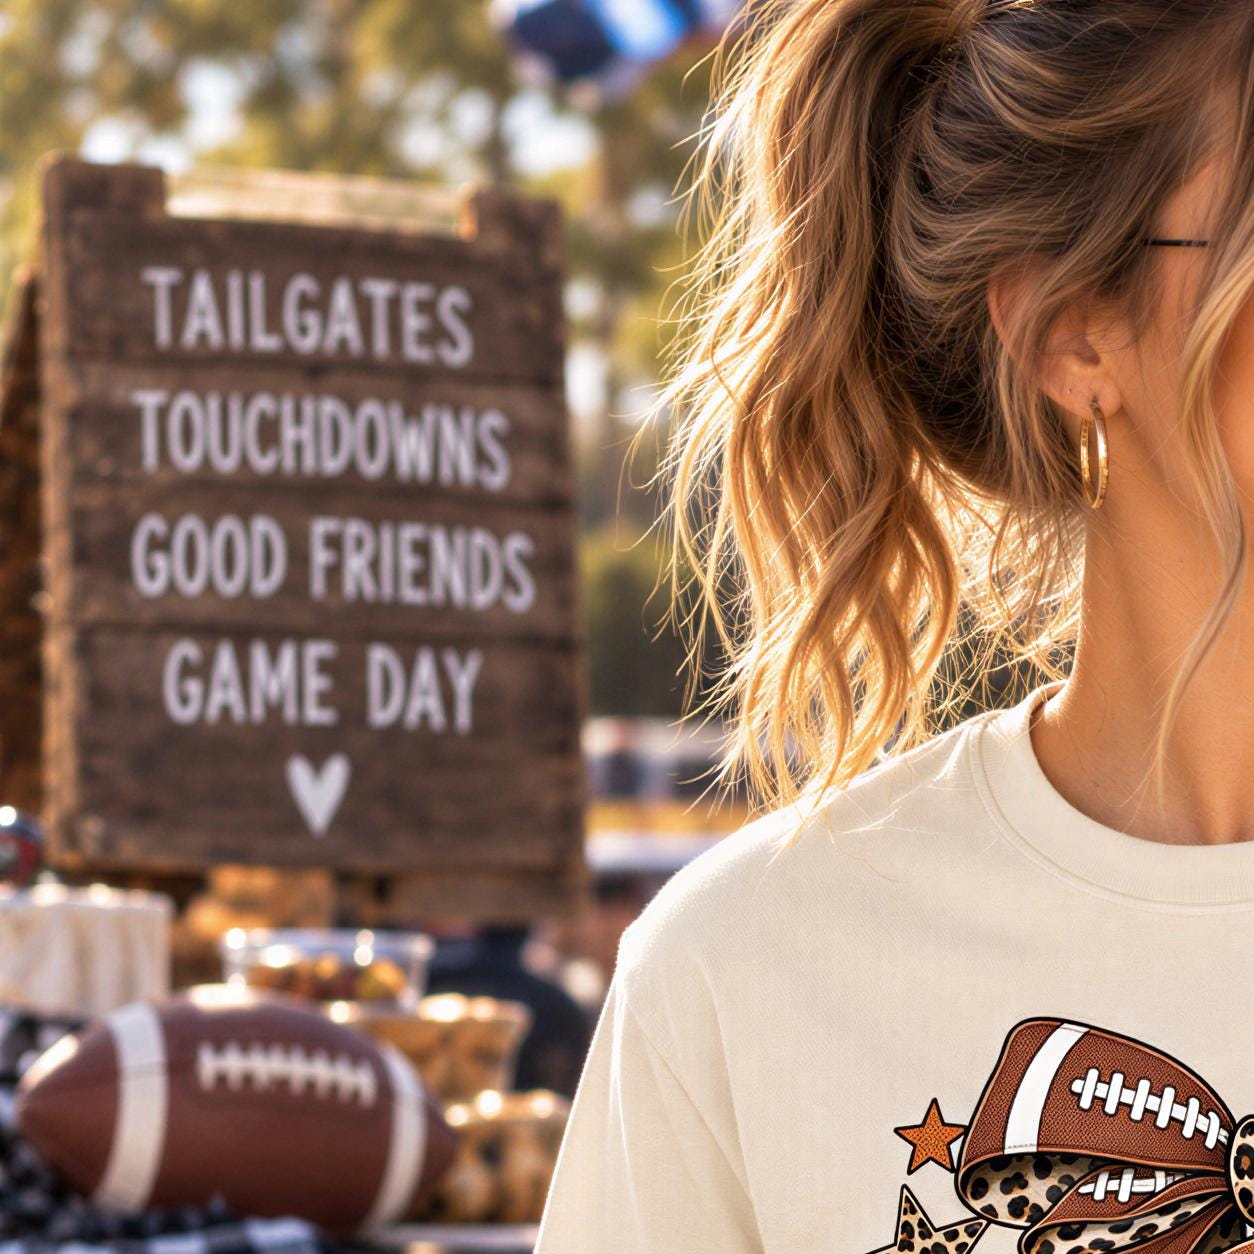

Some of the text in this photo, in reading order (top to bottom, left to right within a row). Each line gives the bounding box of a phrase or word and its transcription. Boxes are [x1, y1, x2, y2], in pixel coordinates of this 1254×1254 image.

[143, 267, 474, 368] TAILGATES
[133, 390, 511, 490] TOUCHDOWNS
[131, 513, 536, 612] GOOD FRIENDS
[163, 639, 484, 734] GAME DAY
